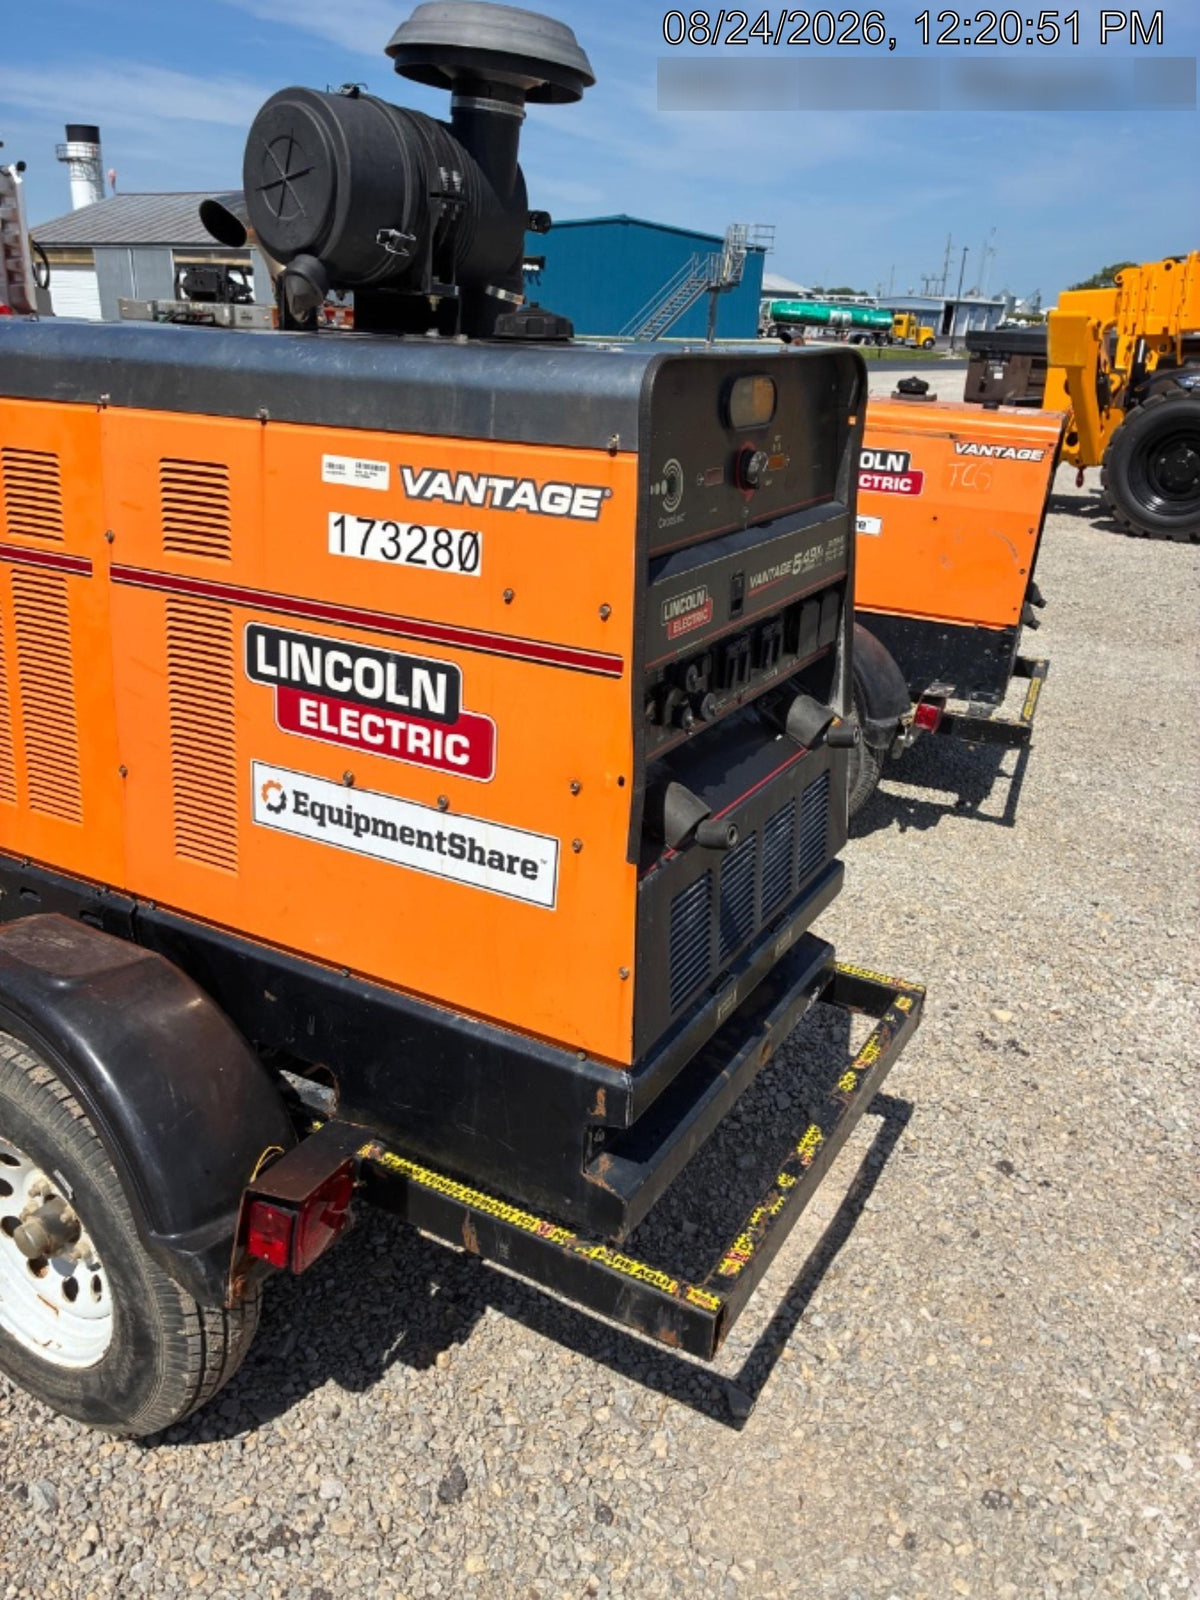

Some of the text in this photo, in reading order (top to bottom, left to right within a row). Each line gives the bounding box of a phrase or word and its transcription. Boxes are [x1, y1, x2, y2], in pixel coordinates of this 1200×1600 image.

[859, 451, 905, 472] OLN
[955, 442, 1045, 461] VANTAGE
[400, 466, 605, 520] VANTAGE
[858, 473, 913, 492] CTRIC
[333, 515, 480, 574] 173280
[664, 589, 705, 620] LINCOLN
[673, 609, 709, 634] ELECTRIC
[256, 634, 447, 715] LINCOLN
[299, 697, 471, 766] ELECTRIC
[292, 789, 540, 881] EquipmentShare
